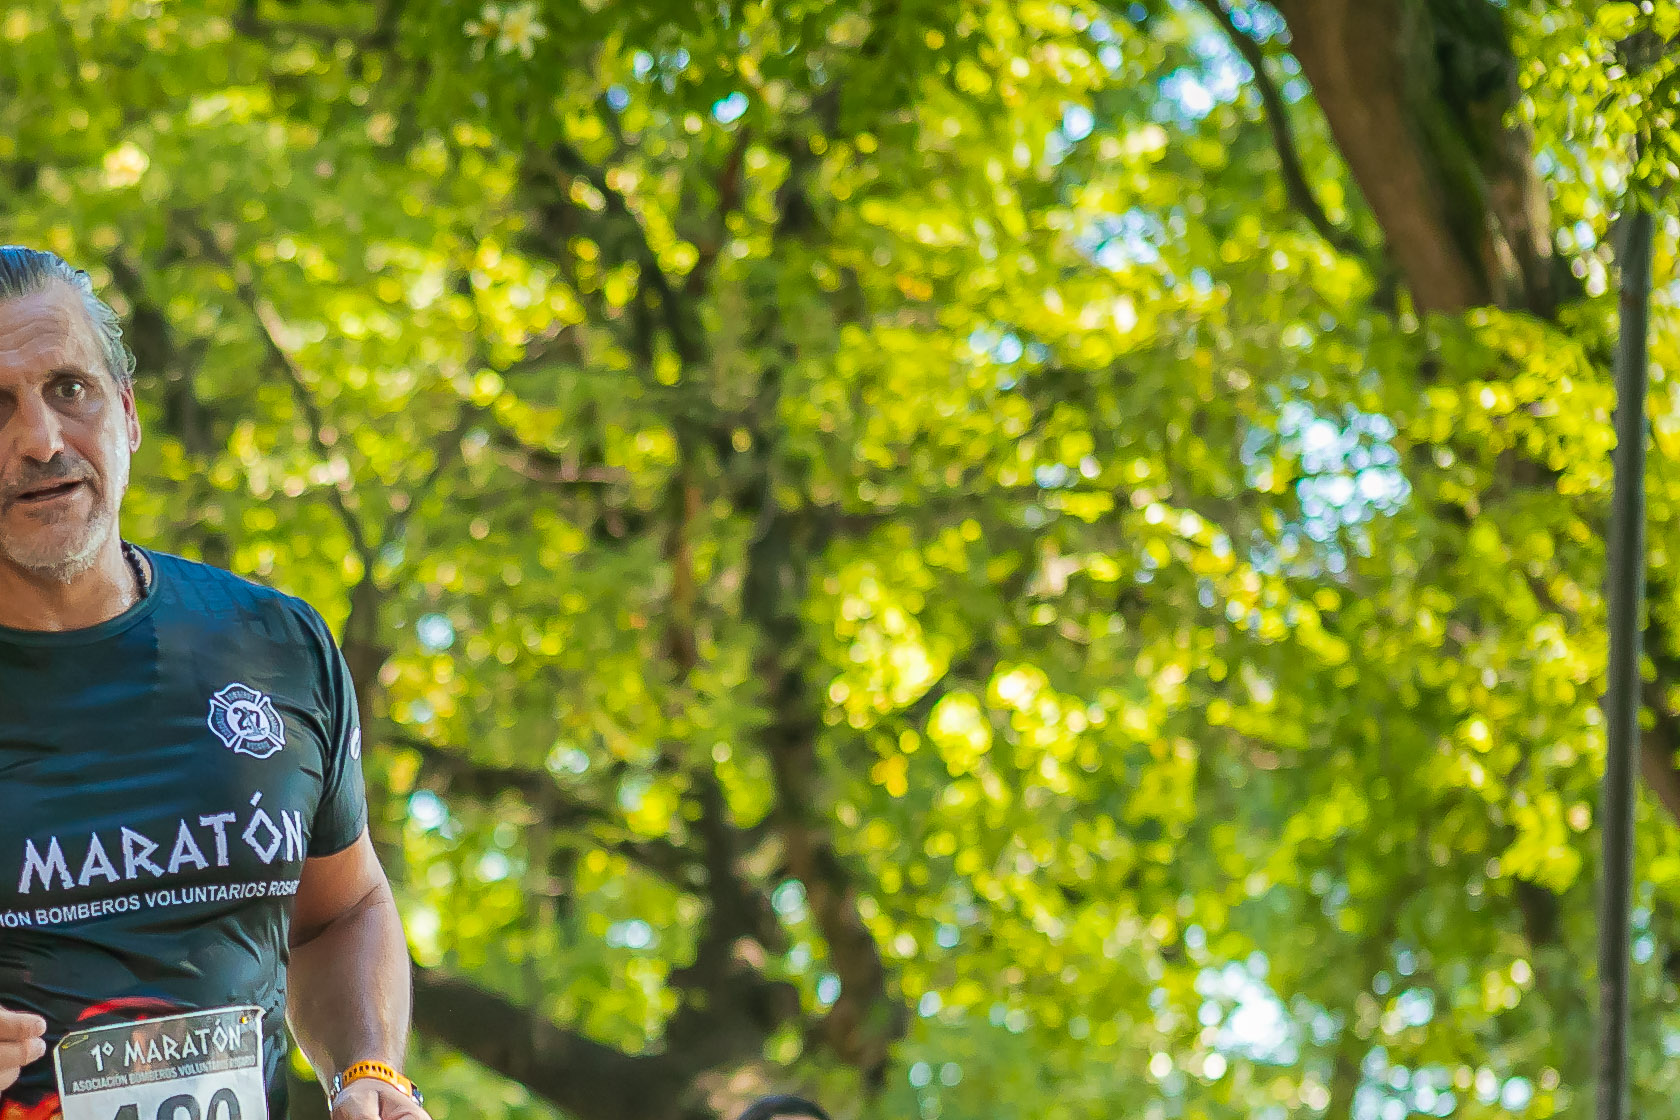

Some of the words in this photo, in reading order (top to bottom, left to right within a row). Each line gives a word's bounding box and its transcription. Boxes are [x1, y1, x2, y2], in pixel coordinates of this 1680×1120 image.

[18, 789, 304, 894] MARATÓN
[35, 894, 141, 925] BOMBEROS
[144, 880, 267, 909] VOLUNTARIOS
[123, 1019, 242, 1068] MARATÓN
